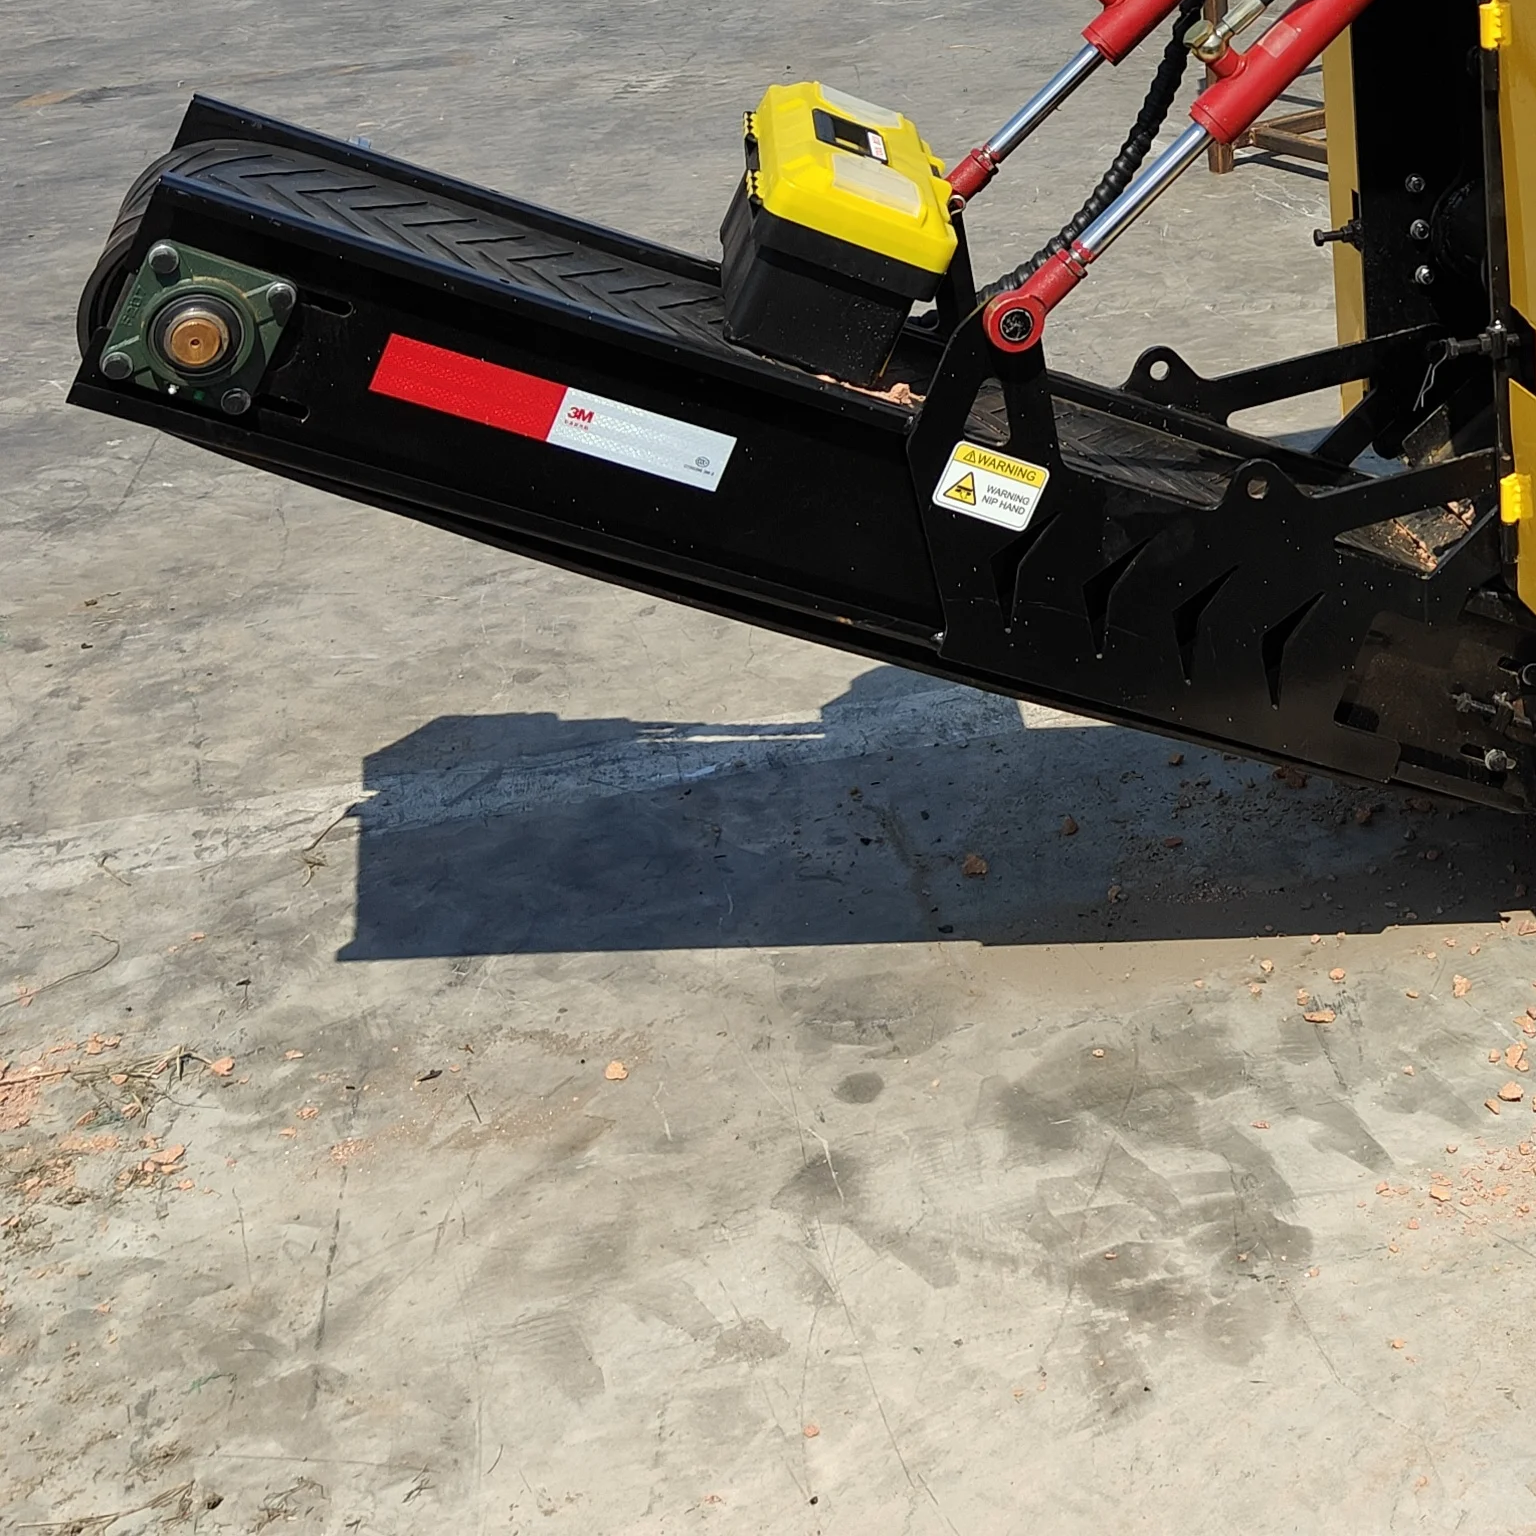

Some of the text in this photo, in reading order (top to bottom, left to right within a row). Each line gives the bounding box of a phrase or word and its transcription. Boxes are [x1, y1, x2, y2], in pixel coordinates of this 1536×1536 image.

[567, 406, 595, 424] 3M
[977, 453, 1037, 482] WARNING
[981, 494, 1026, 515] NIP HAND
[986, 484, 1030, 505] WARNING
